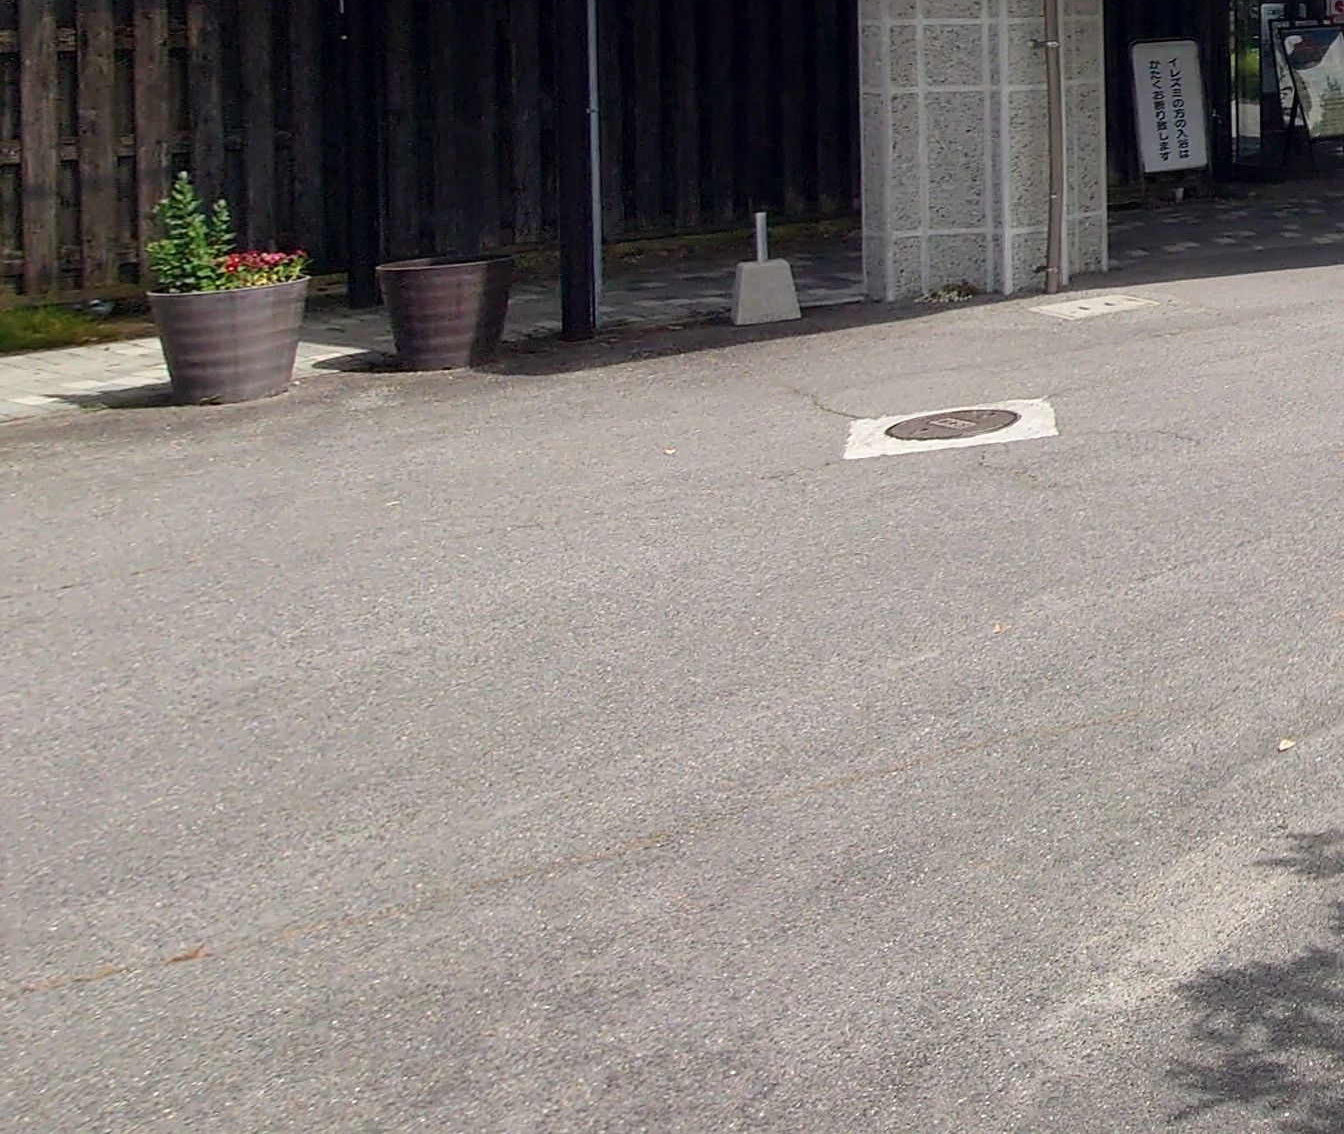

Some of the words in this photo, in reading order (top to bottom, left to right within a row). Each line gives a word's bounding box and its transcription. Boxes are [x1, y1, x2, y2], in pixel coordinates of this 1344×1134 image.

[1168, 57, 1191, 160] イレズミの方の入浴は
